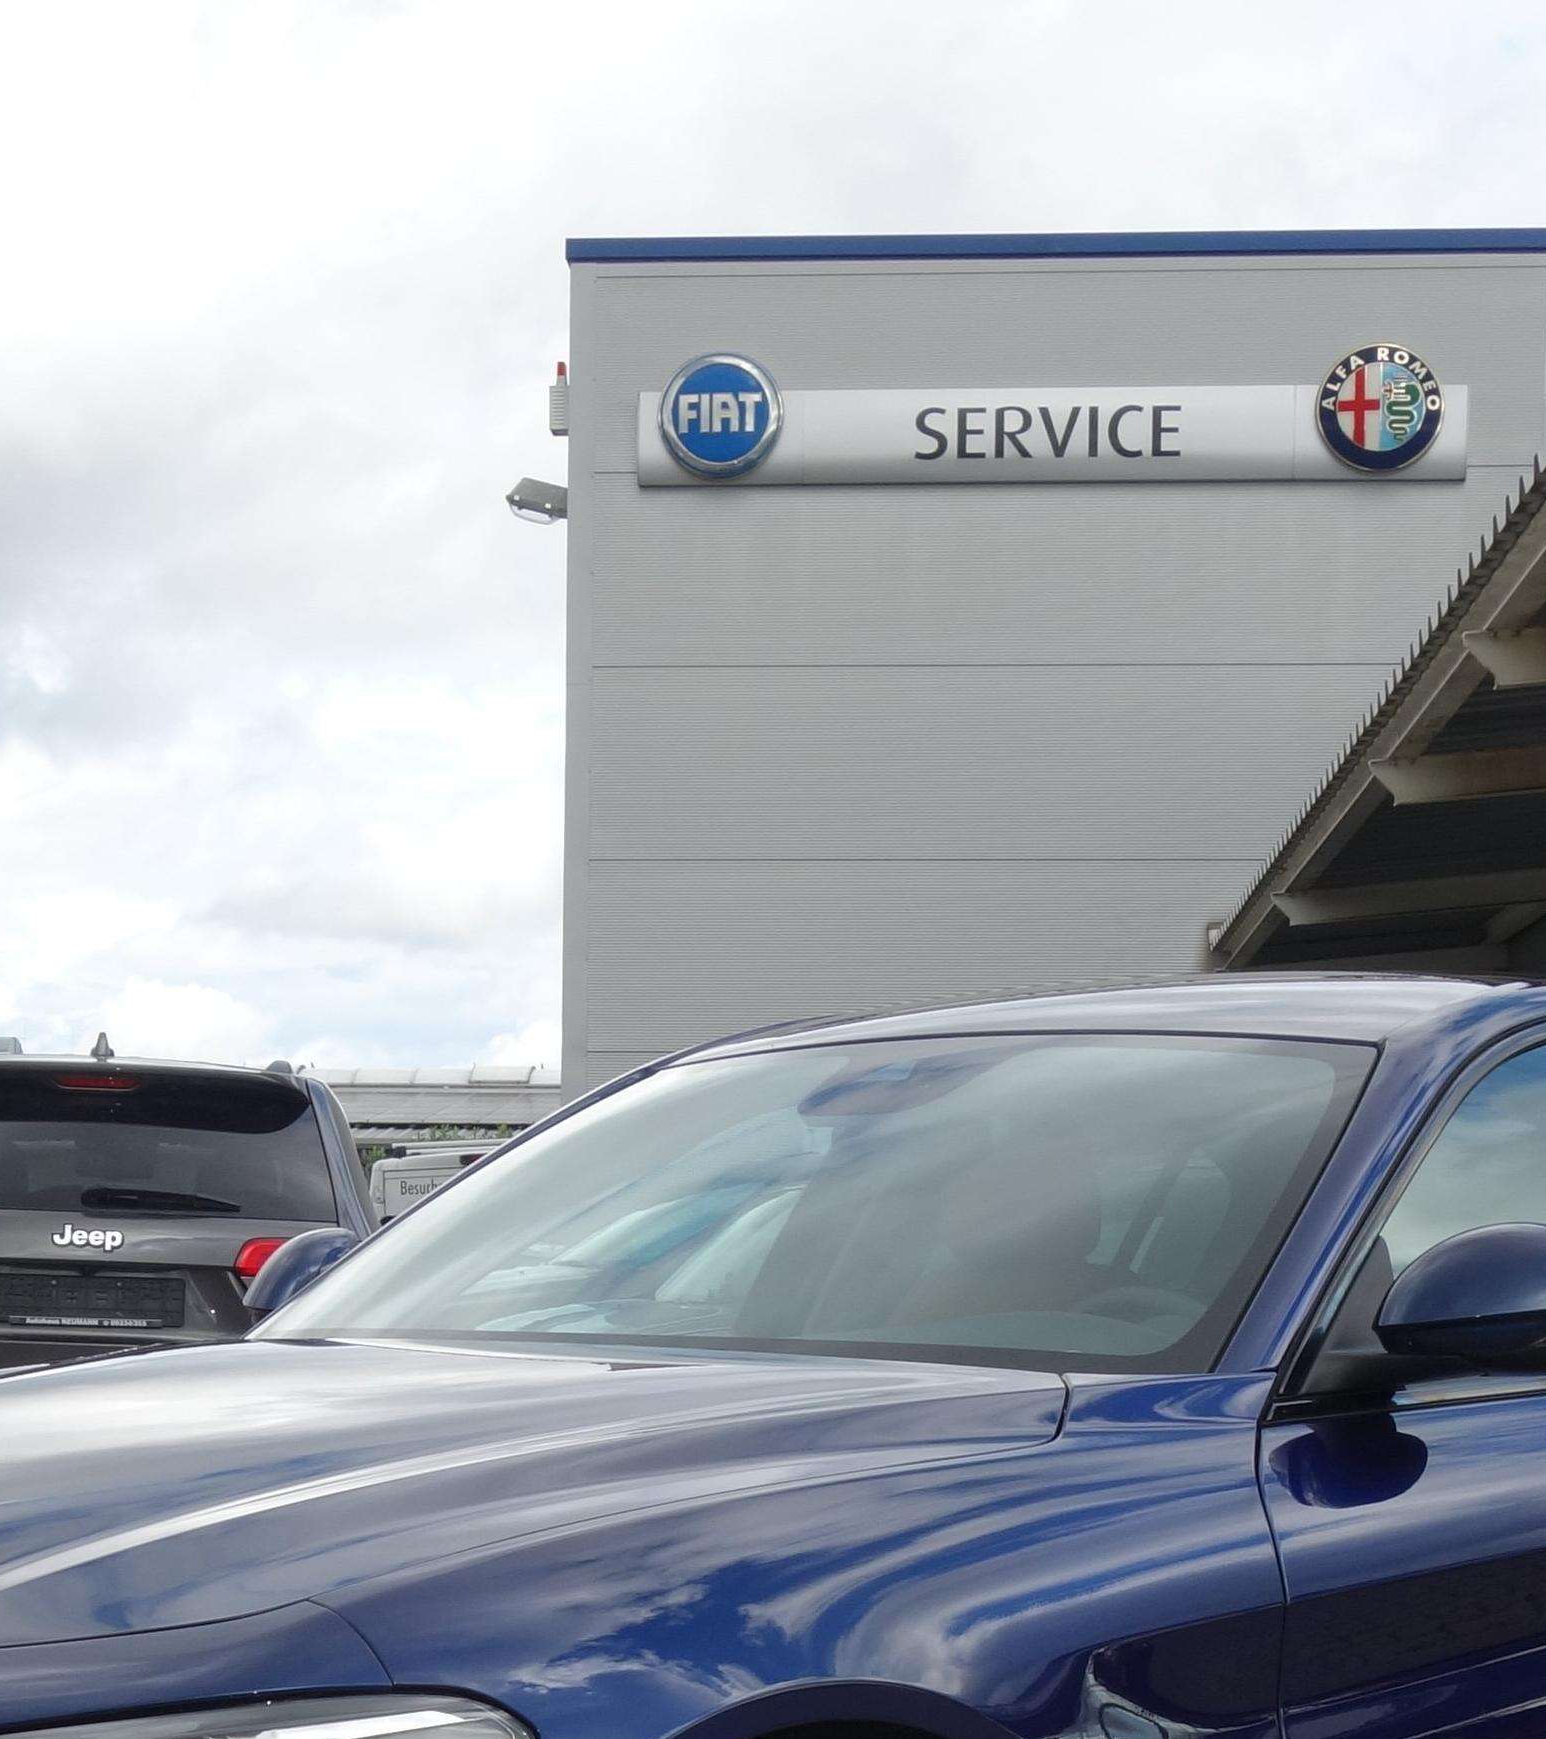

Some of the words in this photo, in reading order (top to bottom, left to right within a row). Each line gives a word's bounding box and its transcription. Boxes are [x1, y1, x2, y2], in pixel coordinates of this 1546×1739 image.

[1321, 355, 1365, 412] ALFA
[1376, 347, 1441, 411] ROMEO
[677, 391, 763, 434] FIAT
[913, 404, 1182, 460] SERVICE
[52, 1223, 124, 1252] Jeep
